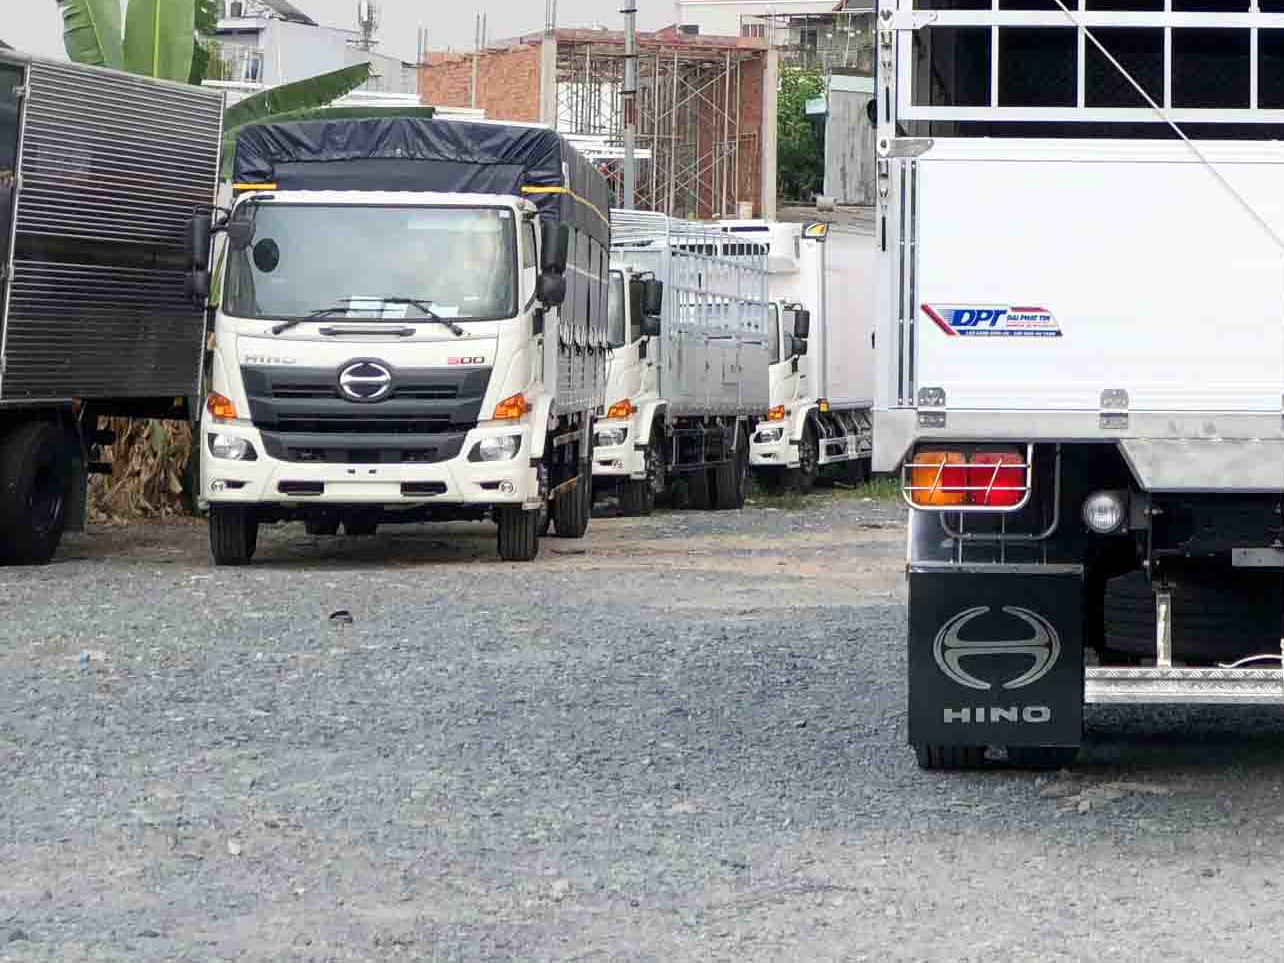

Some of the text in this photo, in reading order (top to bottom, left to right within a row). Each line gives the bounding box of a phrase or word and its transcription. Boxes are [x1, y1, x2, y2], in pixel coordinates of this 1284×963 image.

[951, 309, 1008, 327] DPT
[447, 356, 485, 365] 500
[944, 707, 1051, 723] HINO
